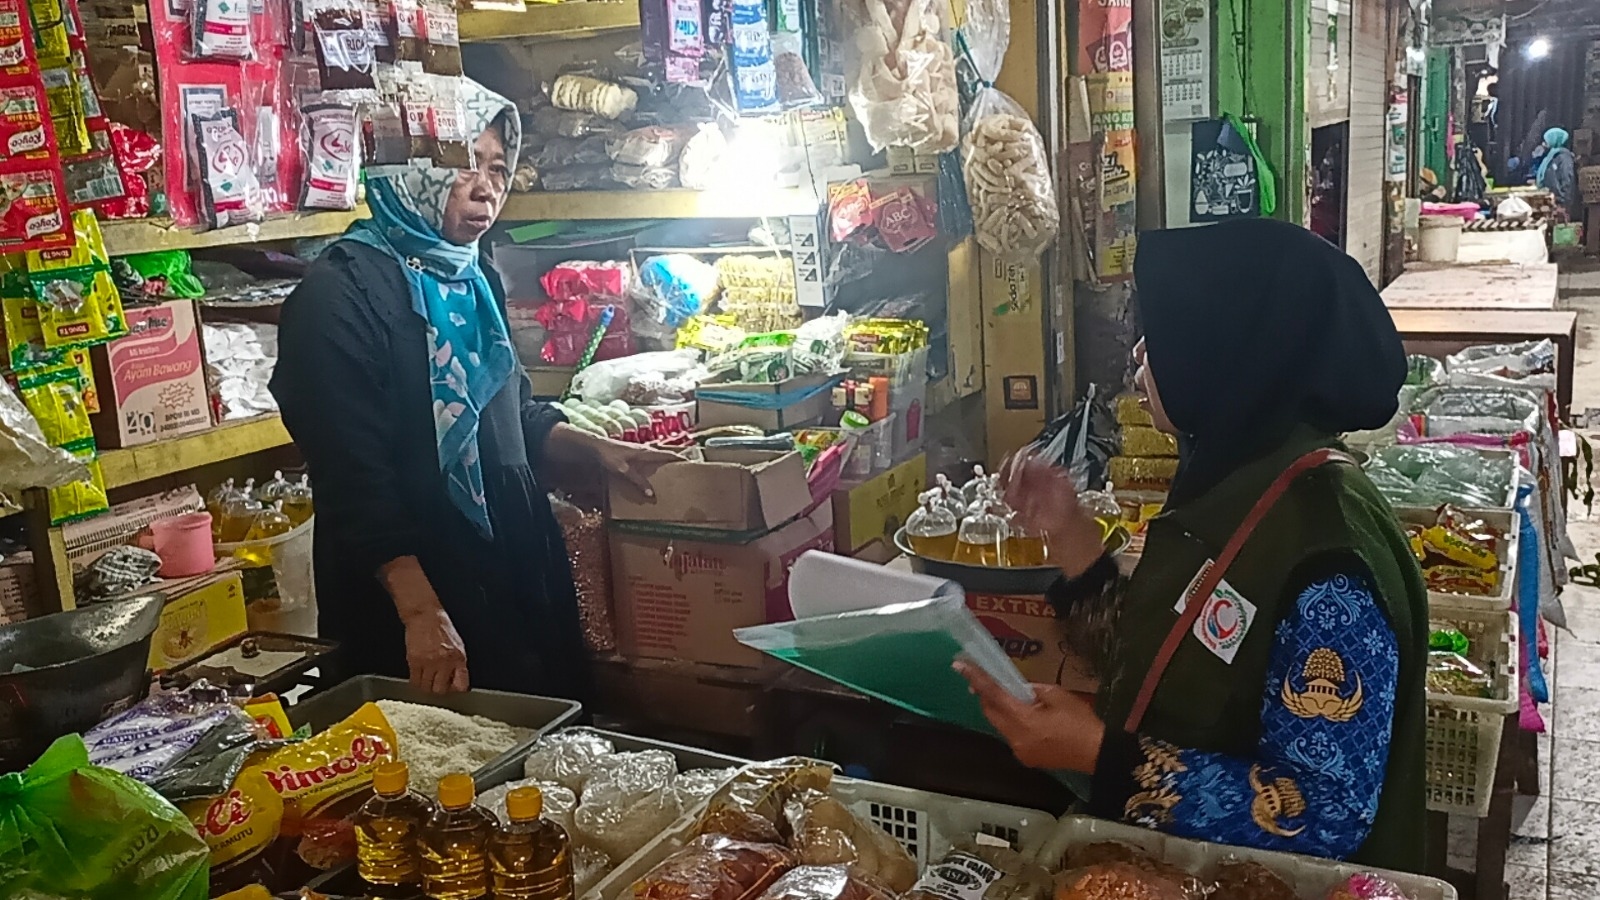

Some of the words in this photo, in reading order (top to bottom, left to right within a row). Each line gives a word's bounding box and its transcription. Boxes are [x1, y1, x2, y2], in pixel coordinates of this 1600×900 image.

[11, 132, 42, 146] Royco
[29, 214, 61, 231] Royco
[886, 208, 911, 228] ABC
[123, 367, 152, 384] Ayam
[153, 360, 192, 377] Bawang
[976, 595, 1056, 617] EXTRA
